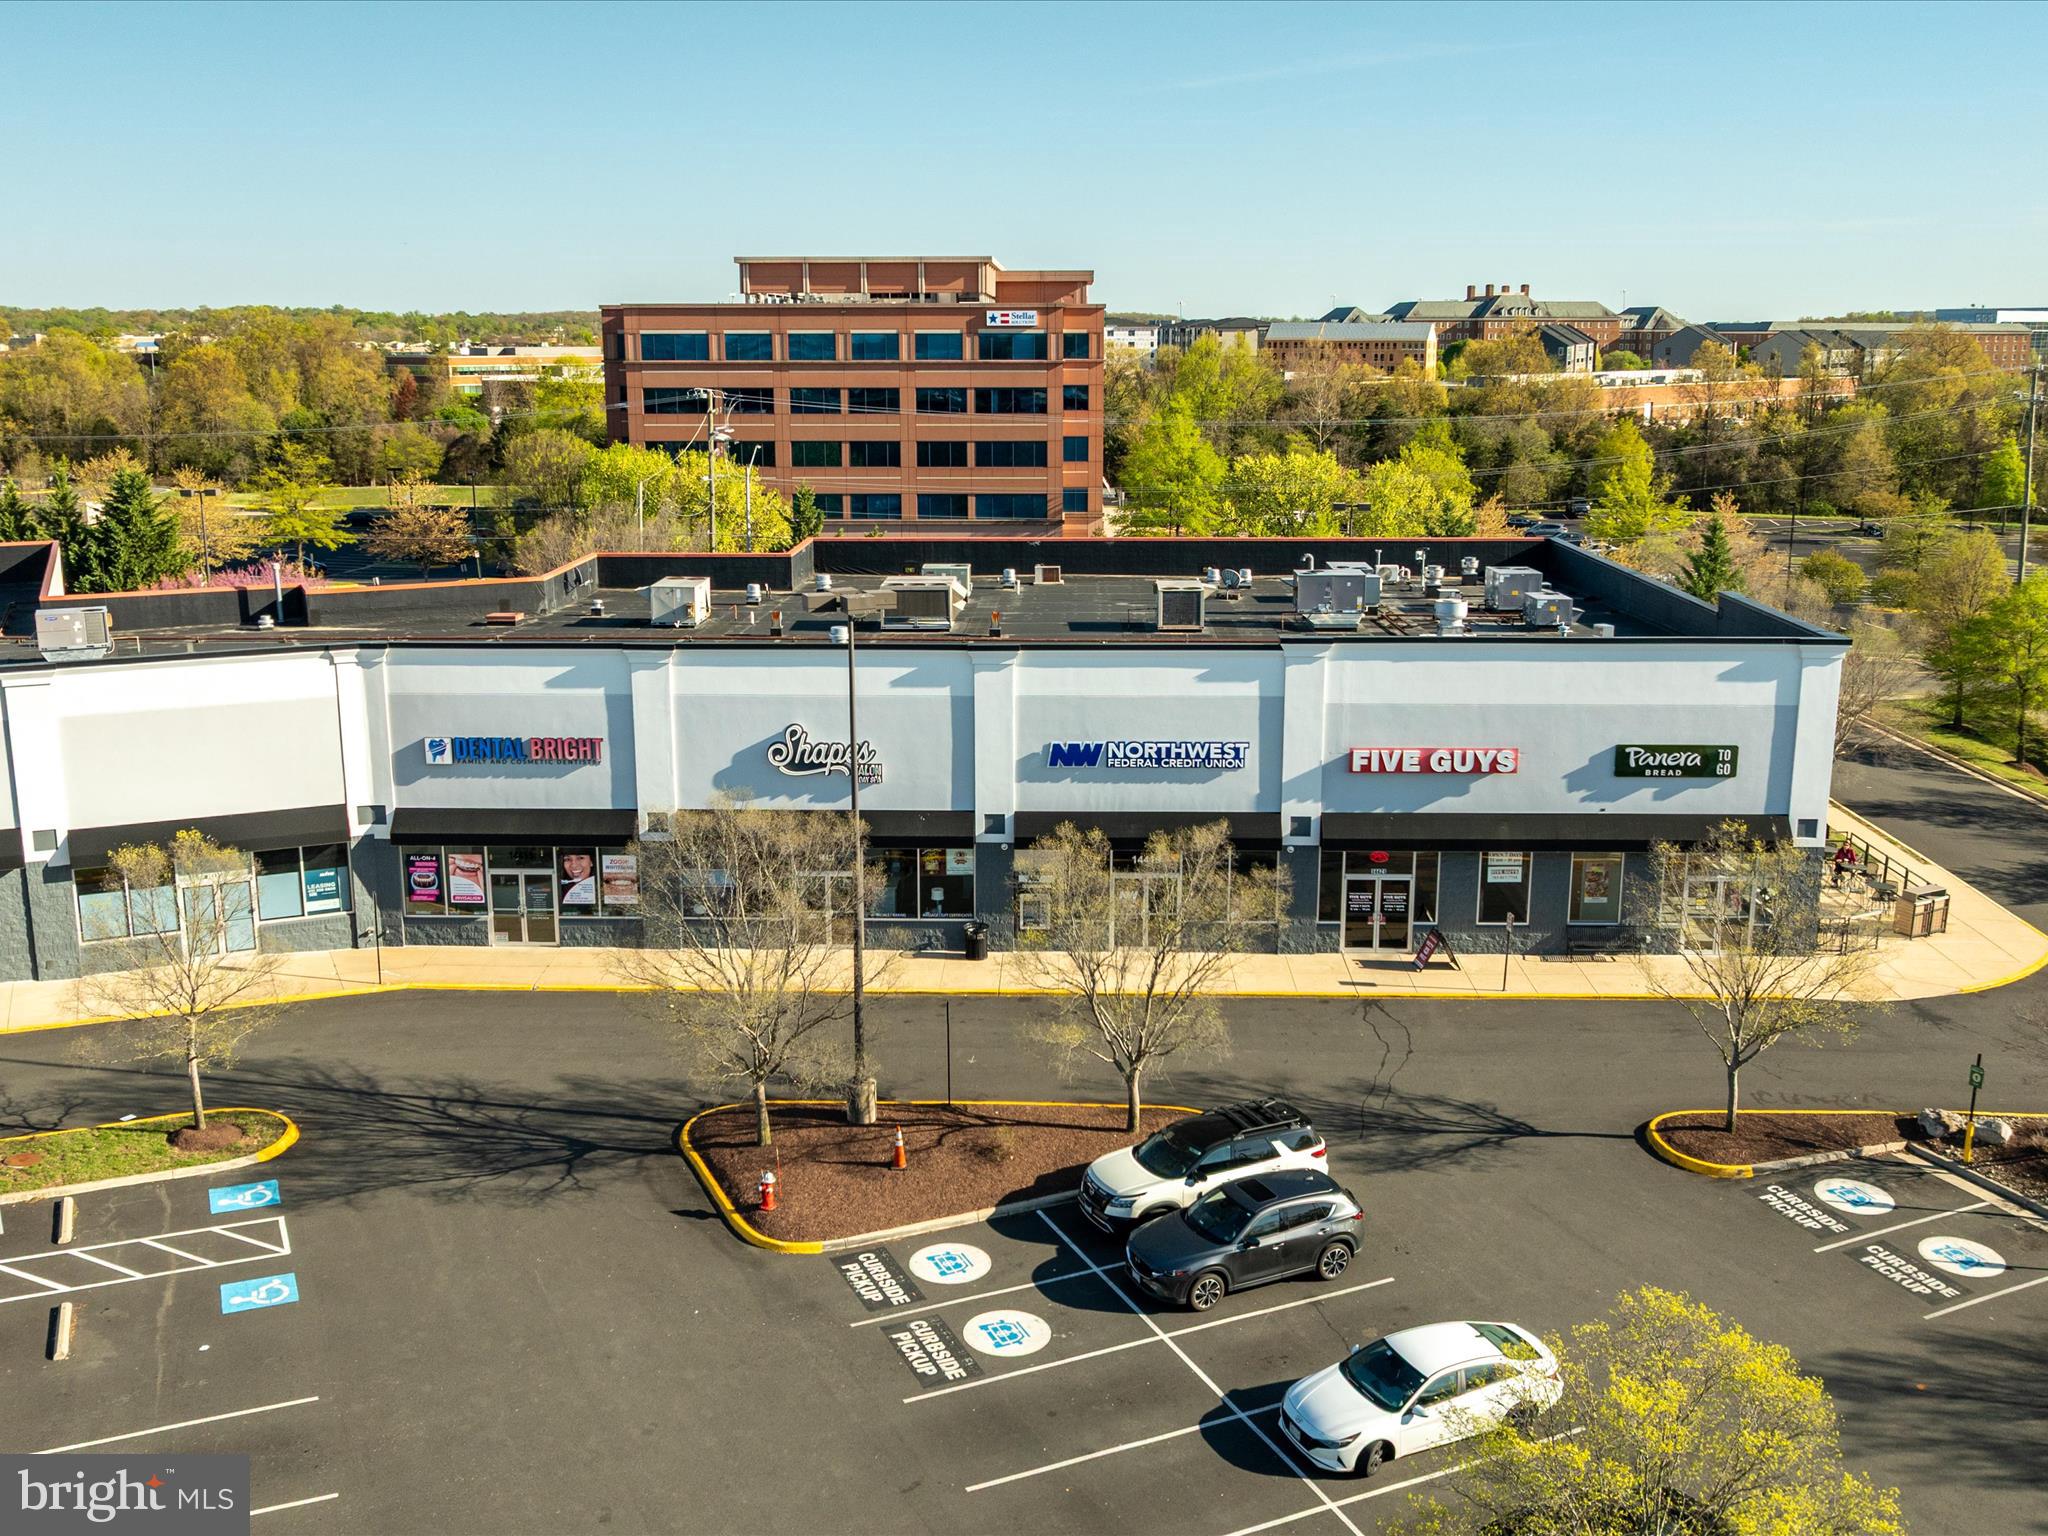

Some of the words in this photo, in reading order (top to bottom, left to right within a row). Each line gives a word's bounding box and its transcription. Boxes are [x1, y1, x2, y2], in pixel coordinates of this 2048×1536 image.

[1011, 312, 1035, 320] Stellar
[453, 737, 527, 760] DENTAL
[530, 737, 603, 760] BRIGHT
[1048, 742, 1105, 768] NW
[1107, 742, 1250, 759] NORTHWEST
[1625, 746, 1701, 767] Panera
[1718, 749, 1731, 761] TO
[856, 763, 882, 776] ALON
[1108, 759, 1159, 768] FEDERAL
[1161, 759, 1202, 768] CREDIT
[1205, 759, 1244, 768] UNION
[1352, 750, 1421, 772] FIVE
[1430, 750, 1516, 772] GUYS
[1716, 763, 1731, 775] GO
[307, 882, 336, 890] LEASING
[1759, 1193, 1823, 1231] PICKUP
[1766, 1185, 1850, 1233] CURBSIDE
[841, 1262, 884, 1303] PICKUP
[858, 1252, 911, 1306] CURBSIDE
[1860, 1254, 1933, 1297] PICKUP
[1866, 1244, 1960, 1298] CURBSIDE
[889, 1331, 938, 1377] PICKUP
[909, 1320, 967, 1381] CURBSIDE
